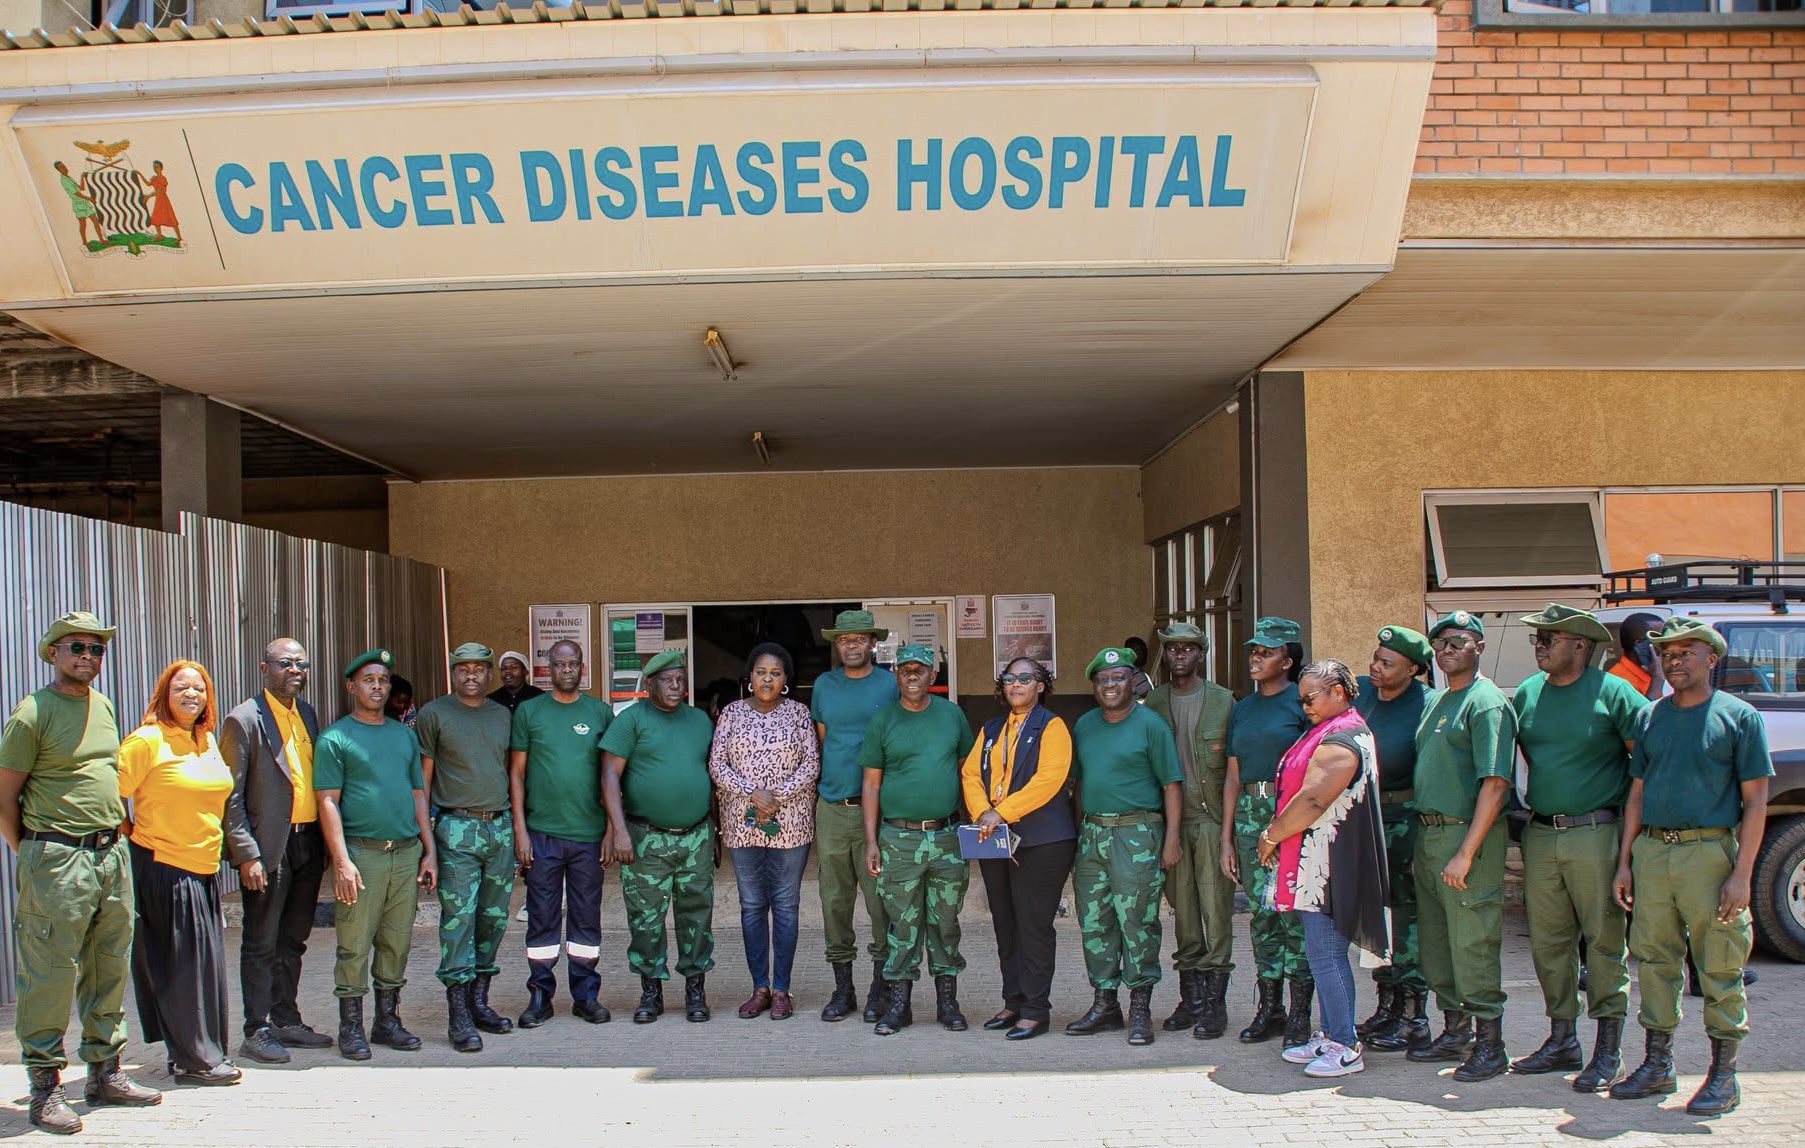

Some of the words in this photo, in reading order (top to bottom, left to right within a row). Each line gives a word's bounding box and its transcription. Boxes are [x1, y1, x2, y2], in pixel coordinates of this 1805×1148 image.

[215, 152, 505, 234] CANCER
[519, 139, 870, 224] DISEASES
[897, 135, 1246, 212] HOSPITAL
[1663, 576, 1677, 584] GUARD
[538, 617, 582, 627] WARNING!
